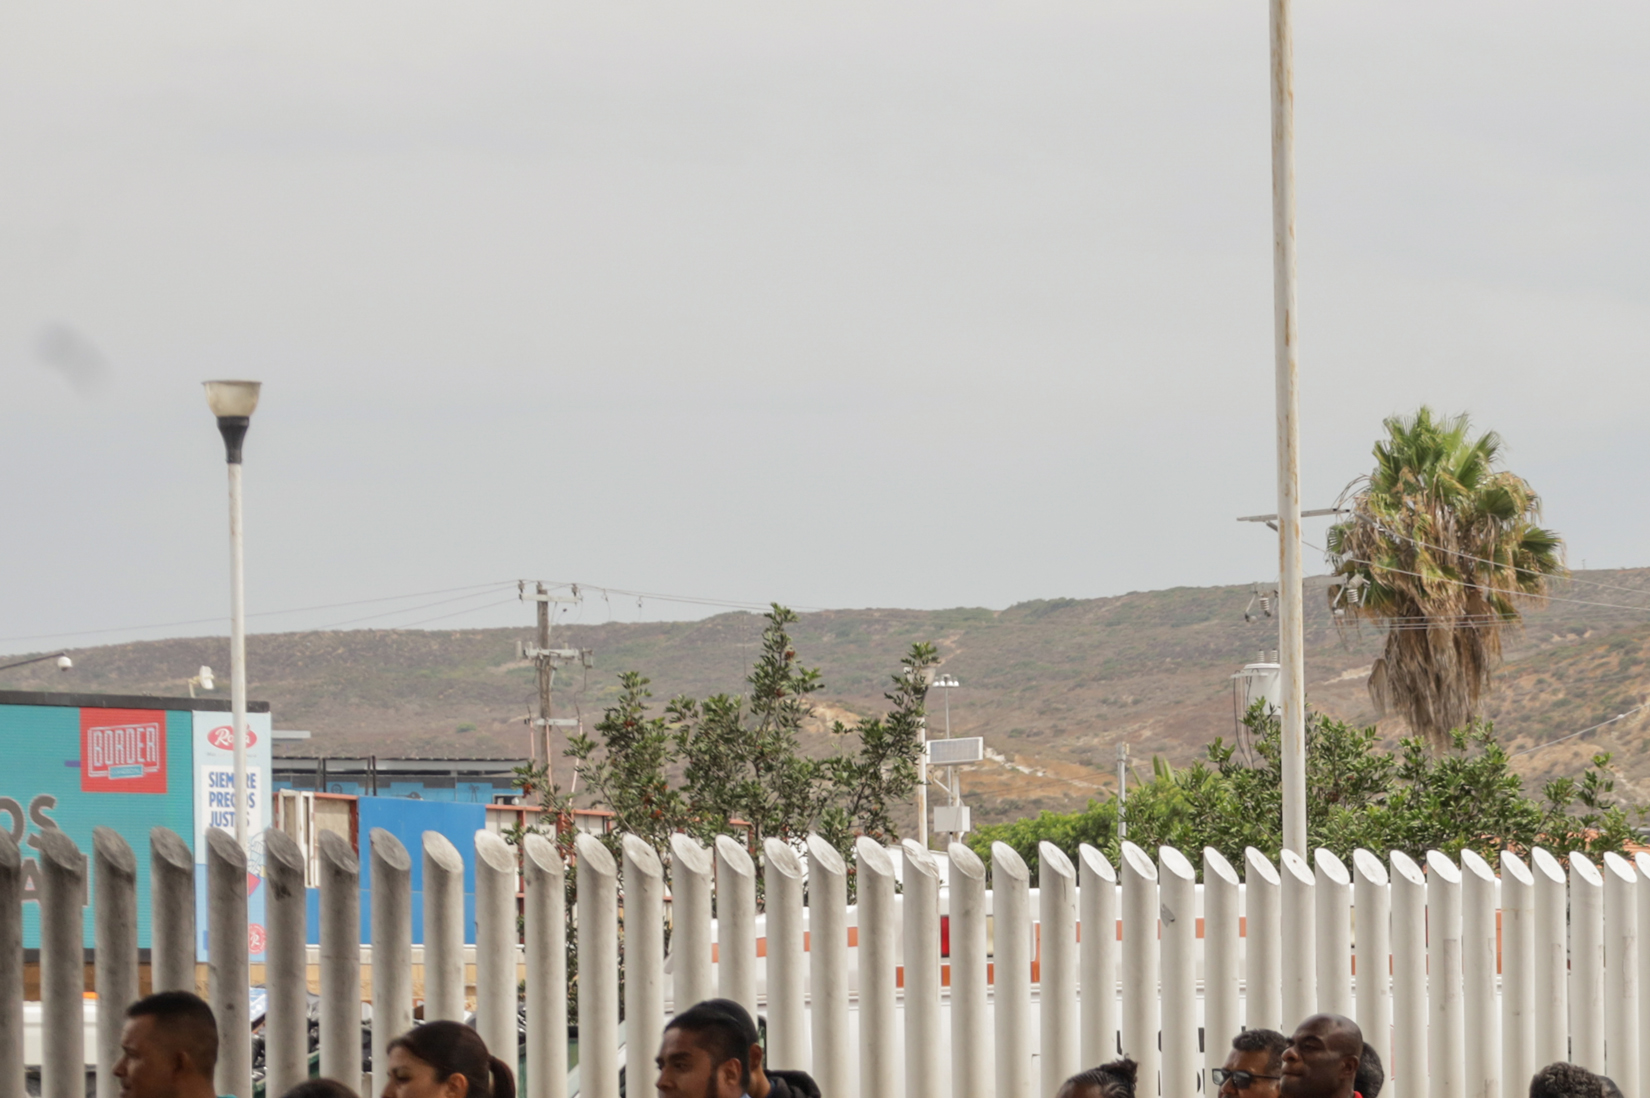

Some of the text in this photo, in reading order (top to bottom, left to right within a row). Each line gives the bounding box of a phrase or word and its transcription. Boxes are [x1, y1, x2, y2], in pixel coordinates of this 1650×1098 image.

[214, 728, 250, 746] Roa
[93, 727, 156, 767] BORDER
[209, 771, 257, 789] SIEME
[209, 791, 255, 808] PRECS
[209, 811, 250, 828] JUST
